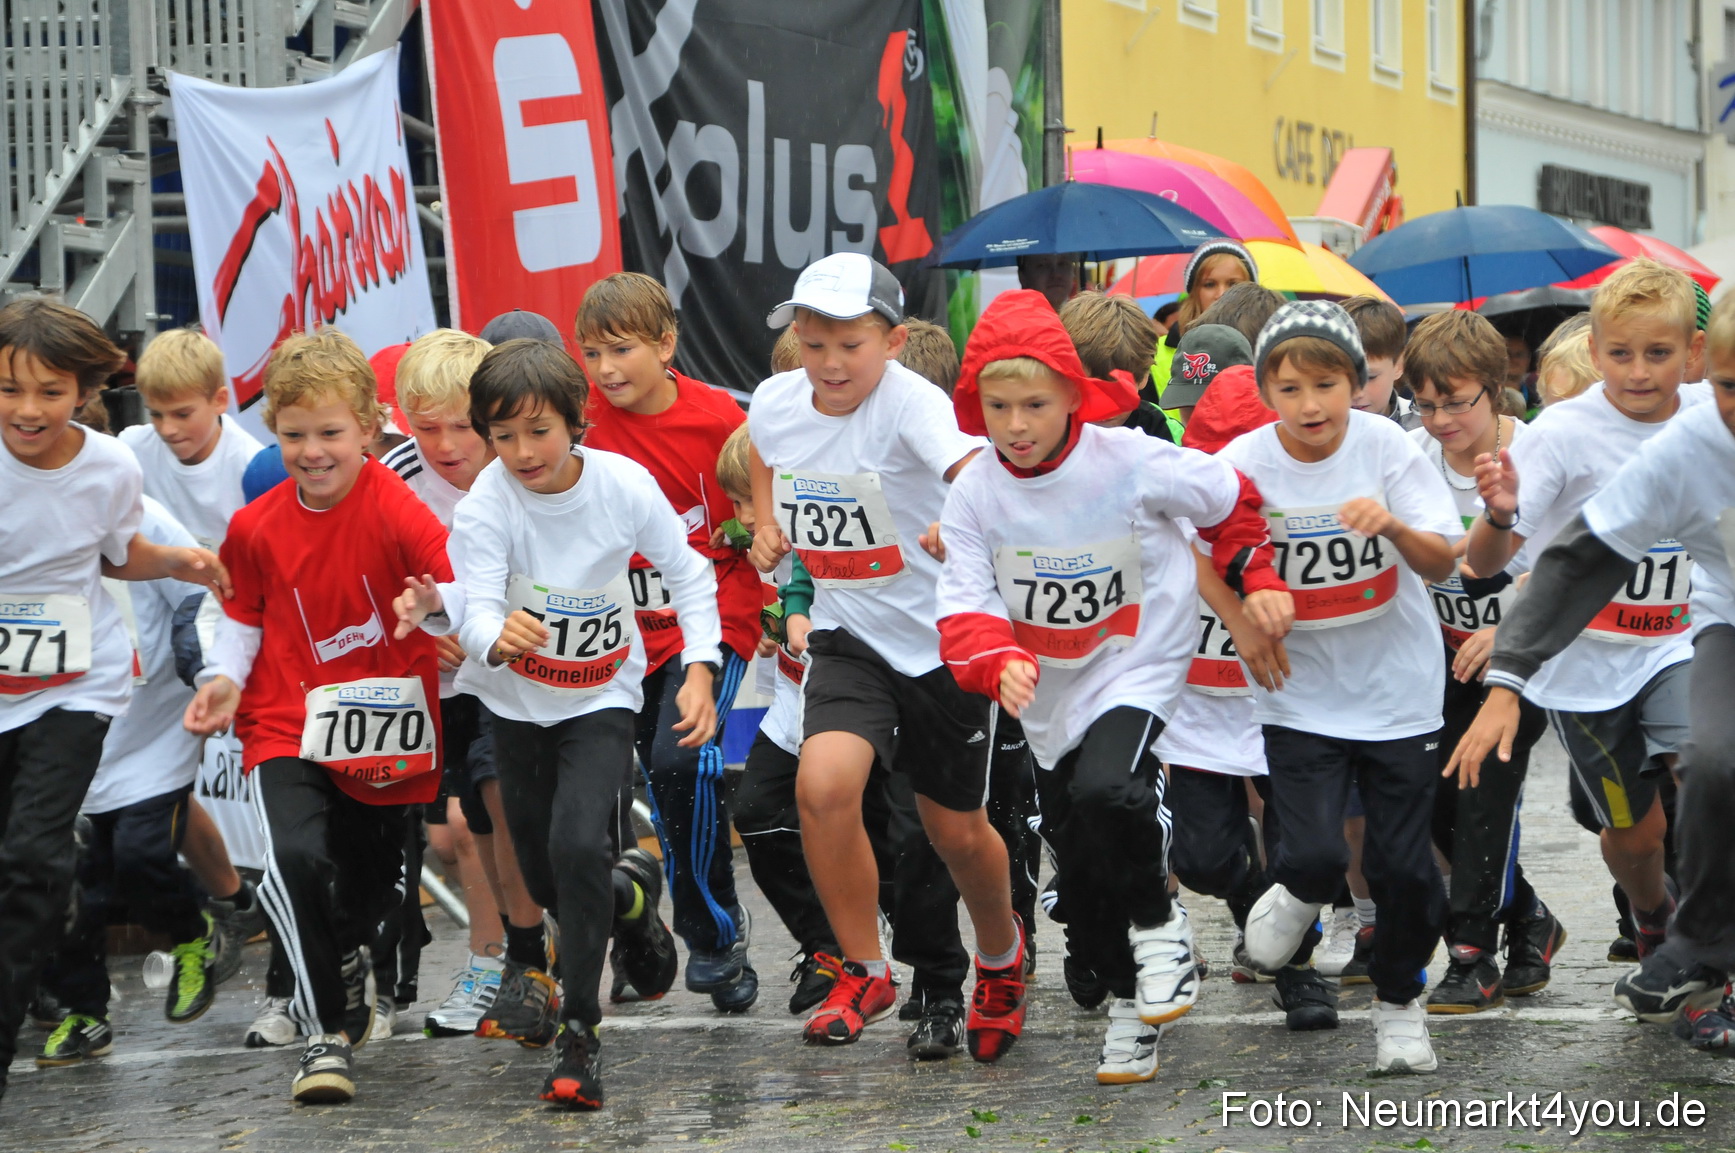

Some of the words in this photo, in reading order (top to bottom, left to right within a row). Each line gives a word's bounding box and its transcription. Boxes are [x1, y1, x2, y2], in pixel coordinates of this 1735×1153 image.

[794, 478, 841, 495] BOCK
[780, 501, 876, 547] 7321
[1033, 553, 1095, 571] BOCK
[1271, 536, 1384, 585] 7294
[546, 593, 606, 610] BOCK
[1012, 570, 1126, 625] 7234
[1616, 608, 1676, 632] Lukas
[338, 631, 366, 650] DEHN
[524, 656, 614, 684] Cornelius
[338, 686, 401, 701] BOCK
[316, 708, 425, 758] 7070
